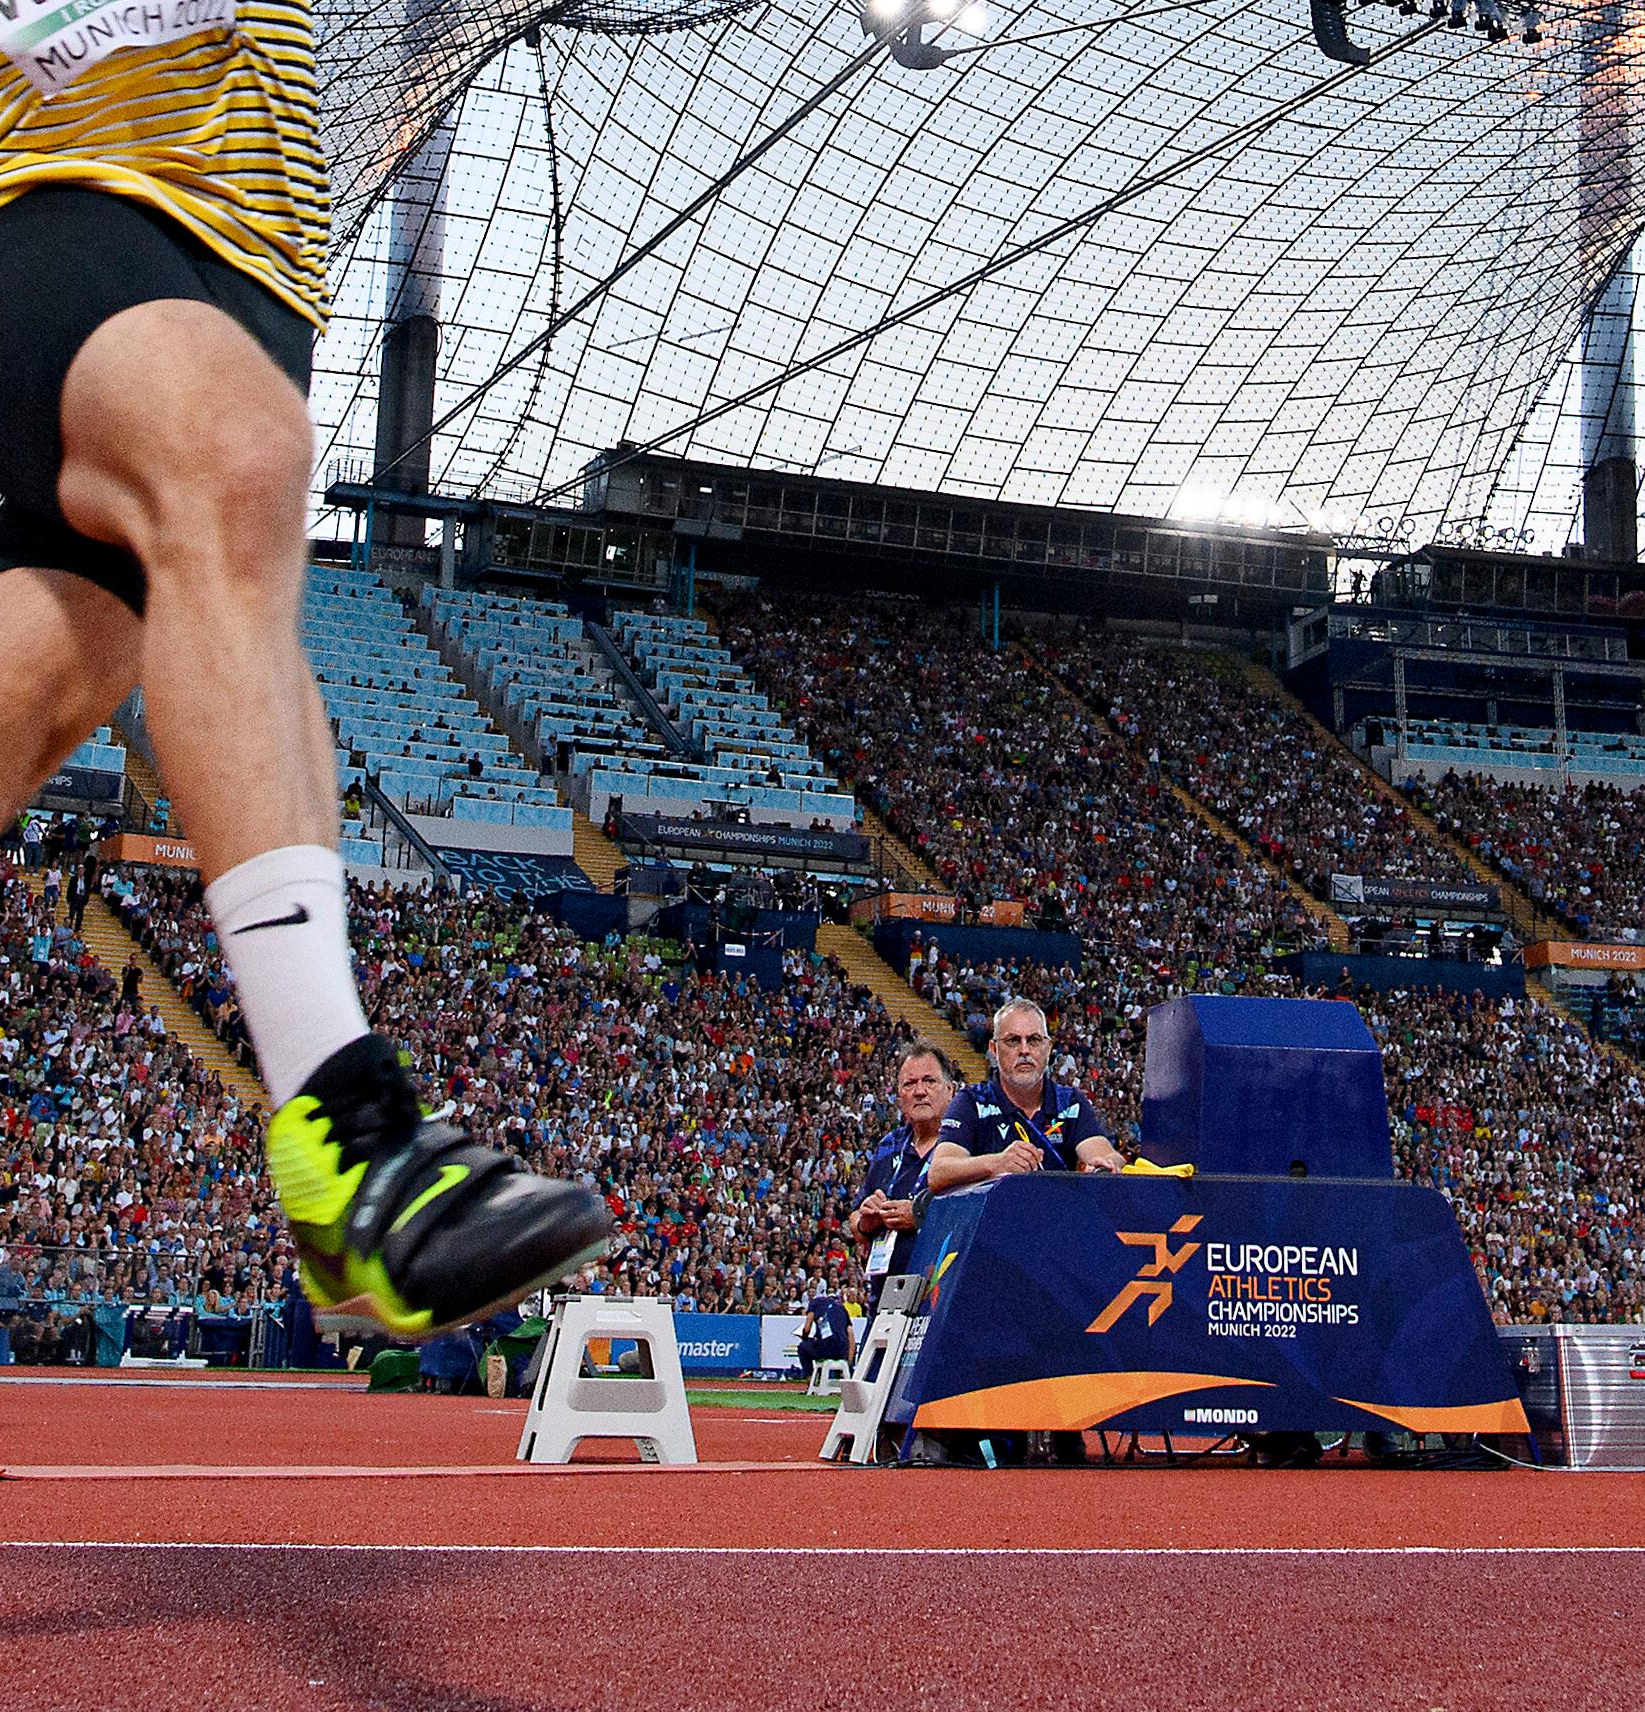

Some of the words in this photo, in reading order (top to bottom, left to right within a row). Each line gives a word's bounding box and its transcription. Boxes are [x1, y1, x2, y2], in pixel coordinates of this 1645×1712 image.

[35, 2, 164, 81] MUNICH
[657, 825, 701, 838] EUROPEAN
[715, 830, 777, 845] CHAMPIONSHIPS
[778, 836, 812, 848] MUNICH
[812, 839, 834, 850] 2022
[440, 850, 545, 872] BACK
[450, 866, 506, 883] TO
[509, 870, 592, 891] THE
[1430, 890, 1489, 903] CHAMPIONSHIPS
[1570, 948, 1611, 961] MUNICH
[1612, 950, 1637, 962] 2022
[1207, 1242, 1358, 1276] EUROPEAN
[1208, 1274, 1332, 1302] ATHLETICS
[1208, 1300, 1359, 1324] CHAMPIONSHIPS
[1208, 1323, 1261, 1337] MUNICH
[1264, 1324, 1297, 1338] 2022
[1196, 1408, 1259, 1424] MONDO
